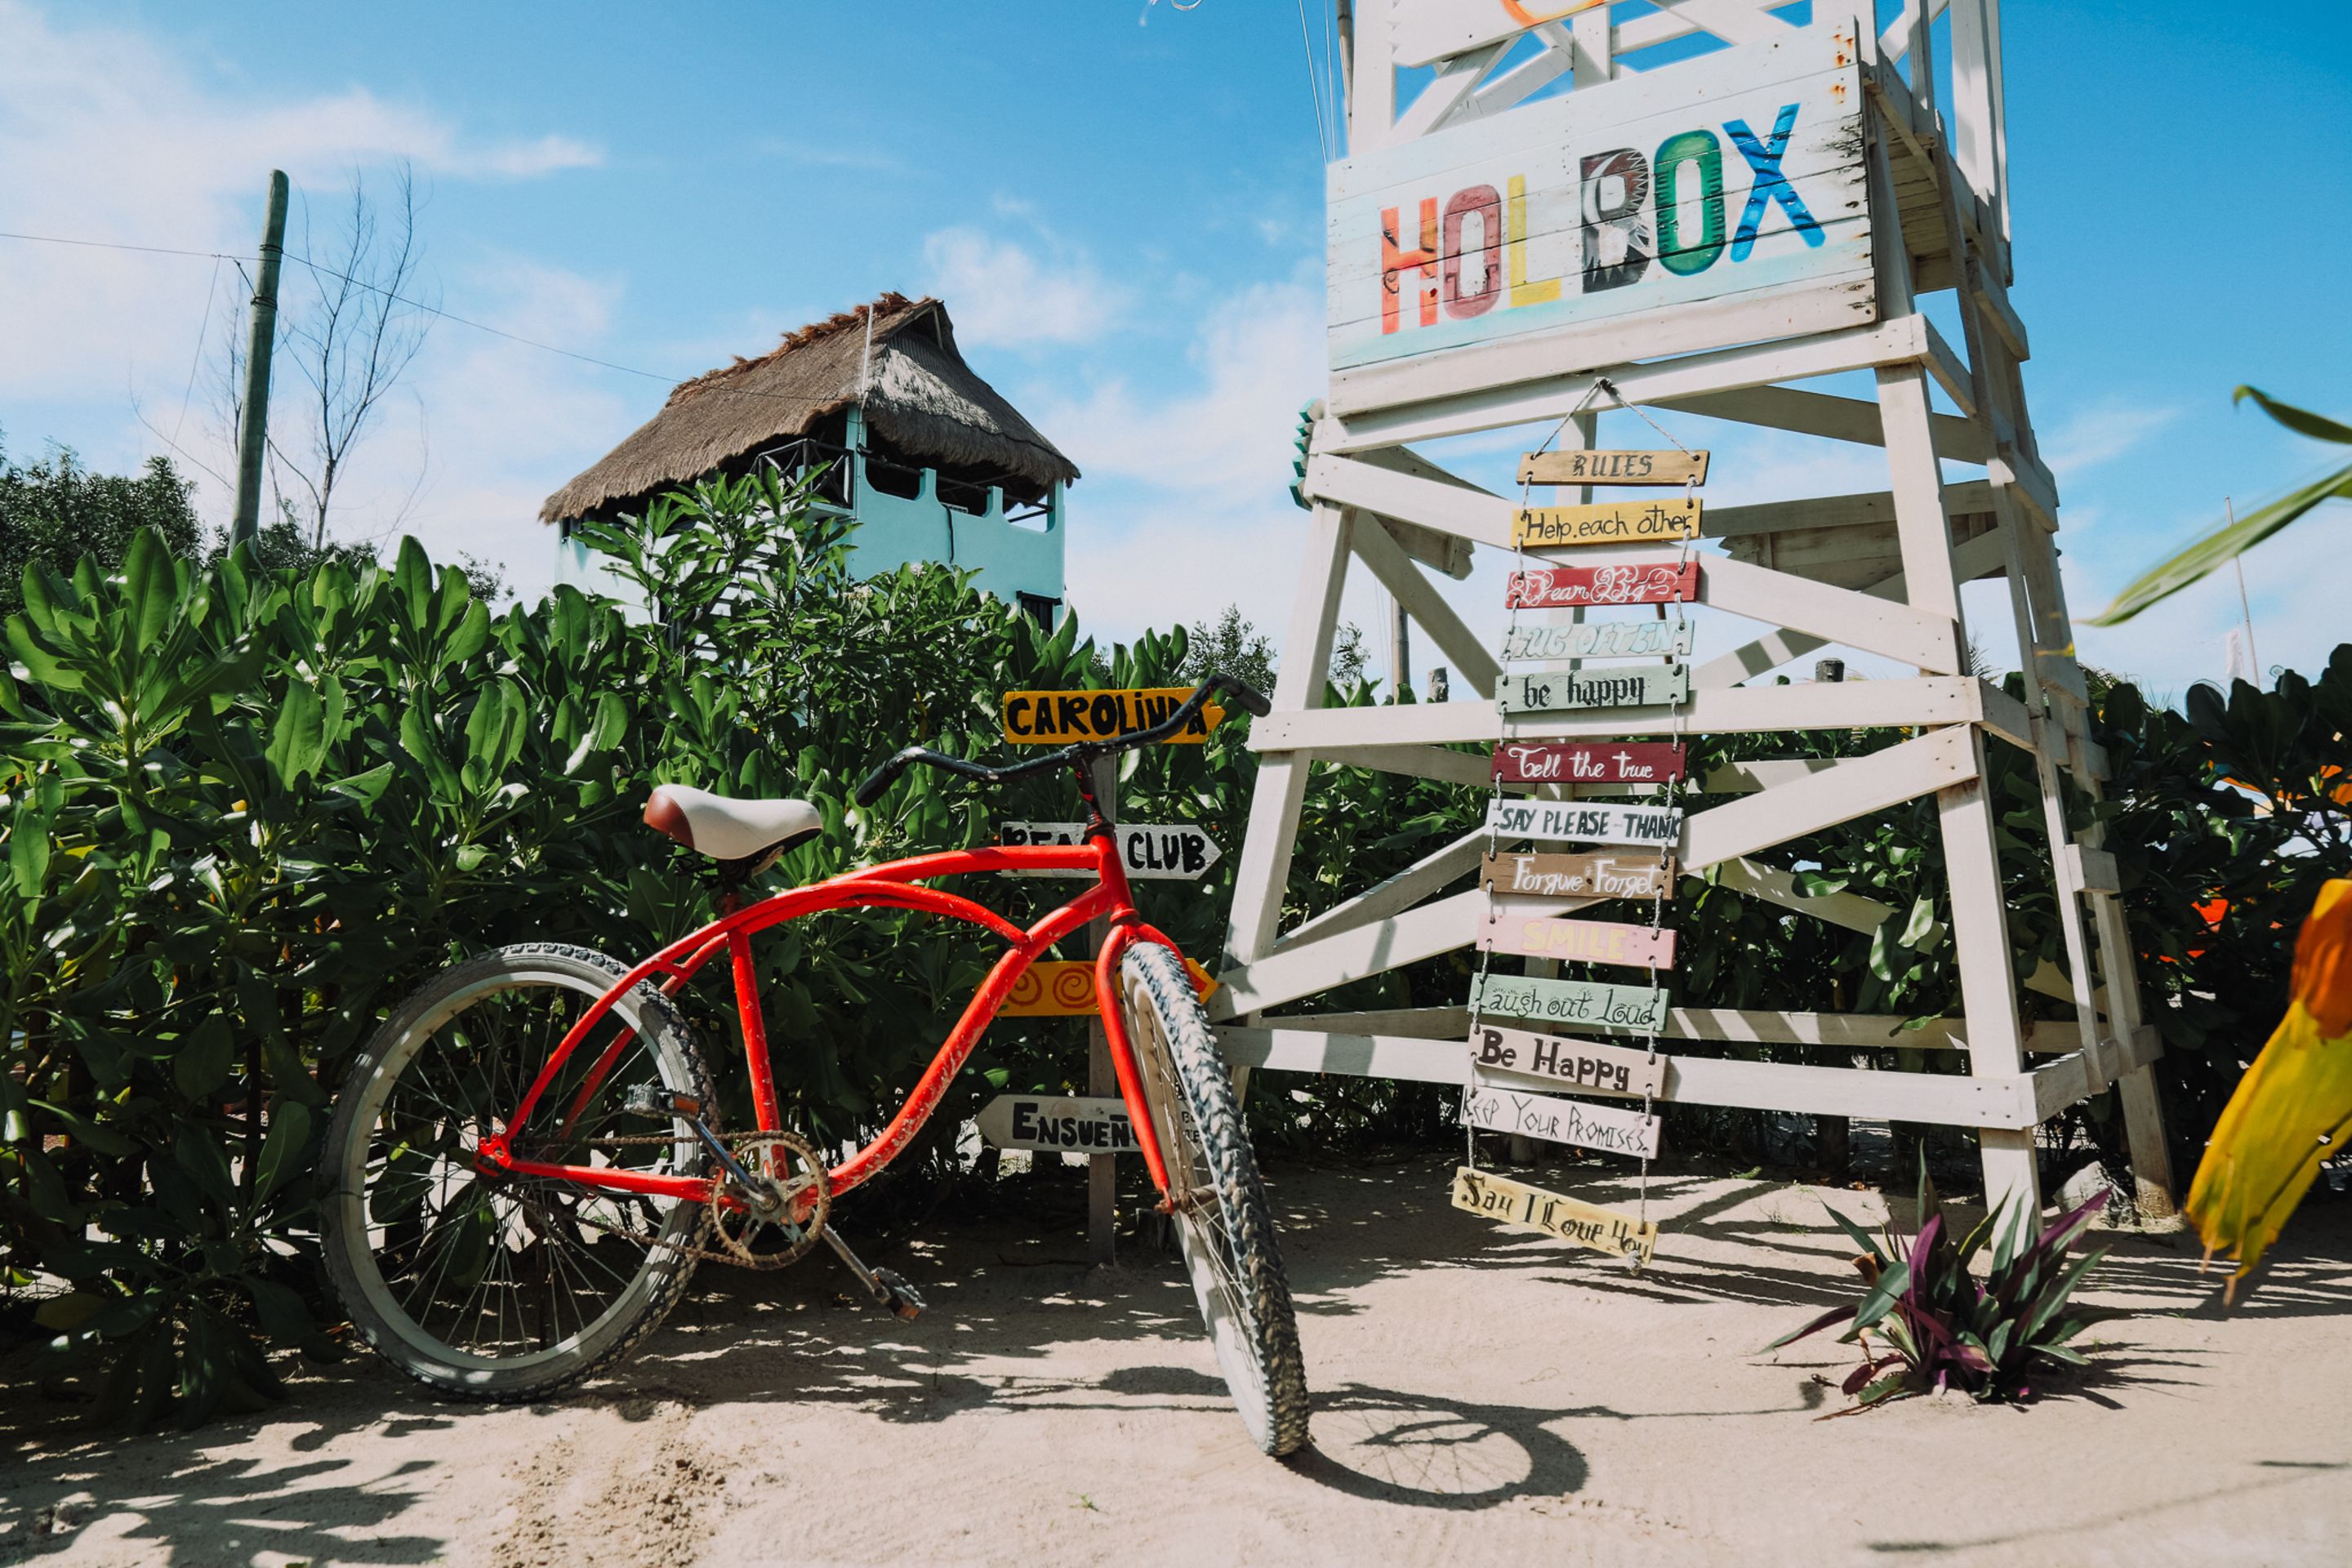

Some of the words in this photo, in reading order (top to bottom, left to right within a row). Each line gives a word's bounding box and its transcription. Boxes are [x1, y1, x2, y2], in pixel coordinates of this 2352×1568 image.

[1381, 103, 1826, 336] HOLBOX
[1572, 454, 1655, 477] RULES
[1579, 510, 1629, 536] each
[1637, 505, 1692, 534] other
[1508, 570, 1589, 606] Dream
[1591, 565, 1677, 603] Big
[1575, 622, 1674, 654] OFTEN
[1523, 674, 1552, 709] be
[1566, 670, 1645, 707] happy
[1508, 746, 1561, 778] Tell
[1568, 751, 1605, 778] the
[1498, 807, 1537, 832] SAY
[1542, 810, 1610, 837] PLEASE
[1623, 813, 1681, 840] THANK
[1127, 832, 1206, 873] CLUB
[1512, 857, 1584, 895] Forgive
[1592, 859, 1664, 899] Forget
[1521, 920, 1628, 961] SMILE
[1548, 991, 1593, 1018] out
[1595, 988, 1656, 1025] Loud
[1478, 1030, 1517, 1067] Be
[1531, 1038, 1630, 1092] Happy
[1013, 1102, 1140, 1147] ENSUEÑ
[1463, 1174, 1513, 1217] Say
[1523, 1193, 1539, 1223] I
[1541, 1197, 1604, 1245] Love
